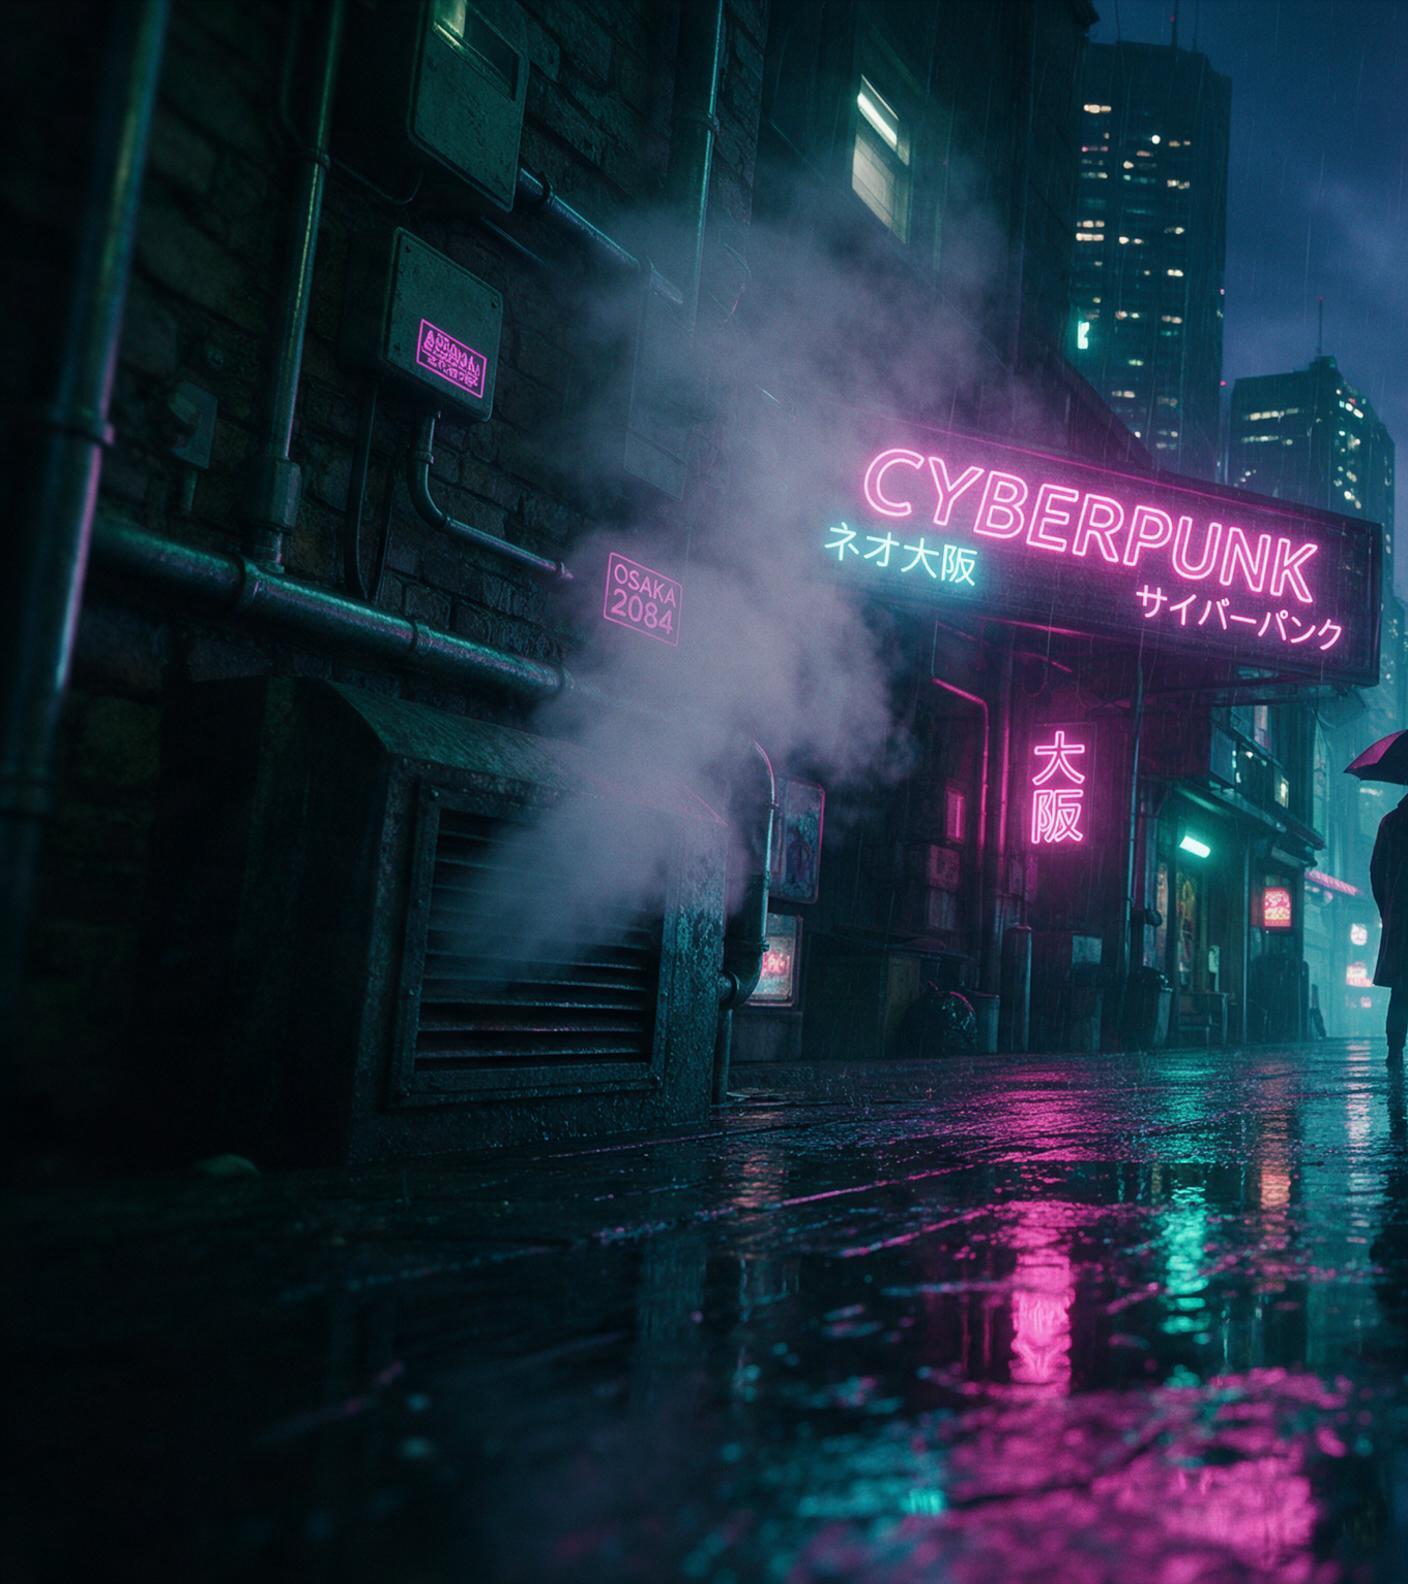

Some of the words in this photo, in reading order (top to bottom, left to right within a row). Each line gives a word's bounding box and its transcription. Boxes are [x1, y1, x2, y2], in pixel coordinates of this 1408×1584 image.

[824, 521, 978, 587] ネオ大阪
[863, 448, 1318, 603] CYBERPUNK
[610, 588, 673, 635] 2084
[613, 563, 676, 608] OSAKA
[1135, 584, 1343, 651] サイバーパンク
[1031, 730, 1086, 844] 大阪
